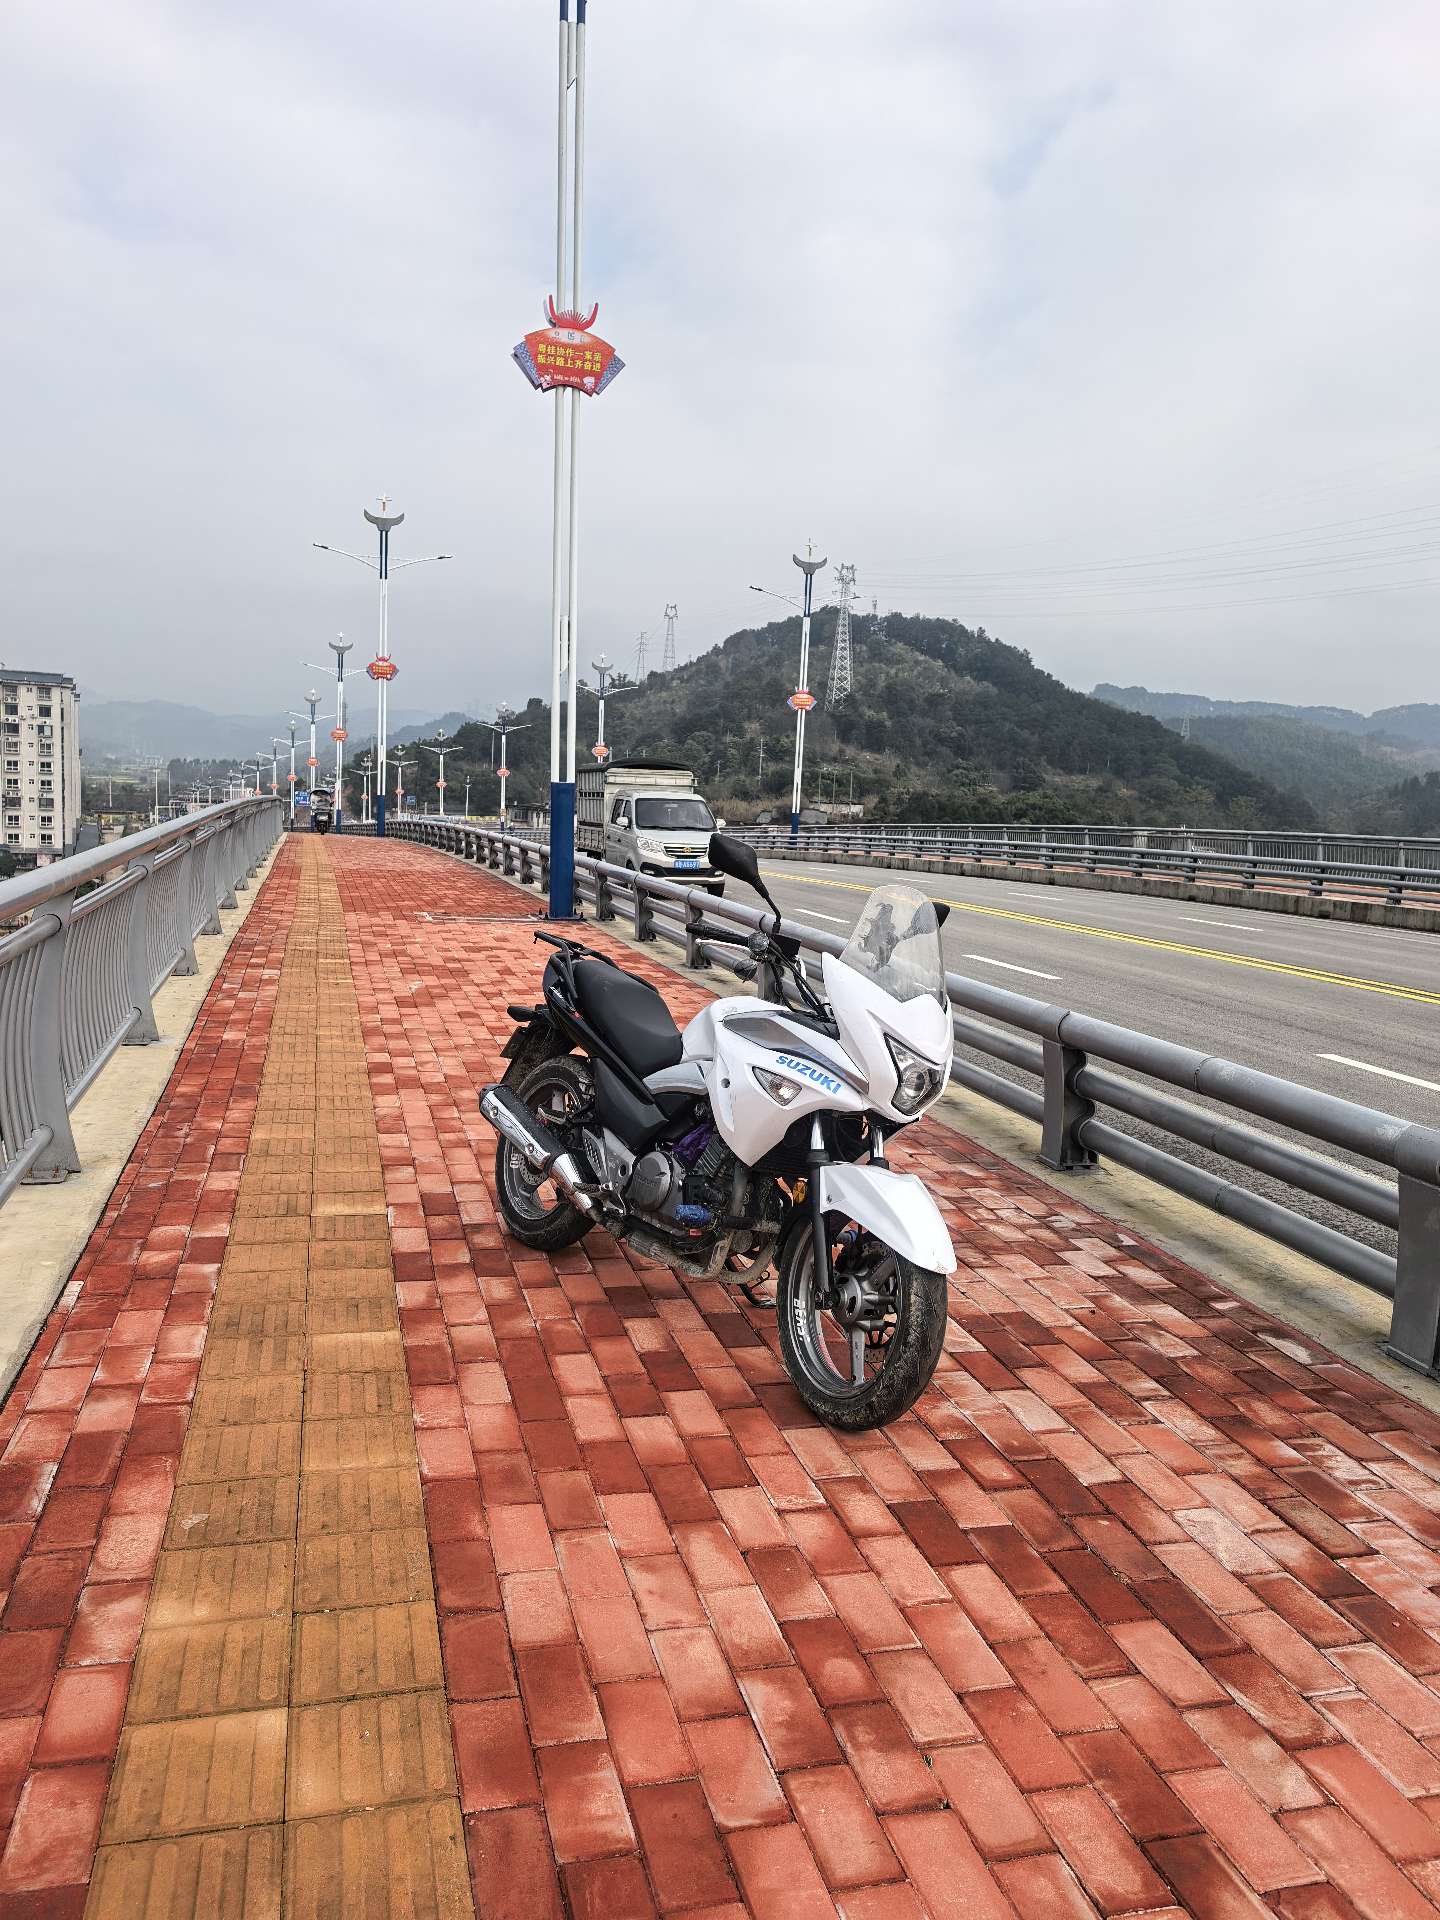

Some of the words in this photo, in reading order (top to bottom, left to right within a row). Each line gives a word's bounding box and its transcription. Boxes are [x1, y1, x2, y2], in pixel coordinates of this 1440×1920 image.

[537, 354, 601, 372] 振兴路上齐奋进
[775, 1055, 842, 1095] SUZUKI
